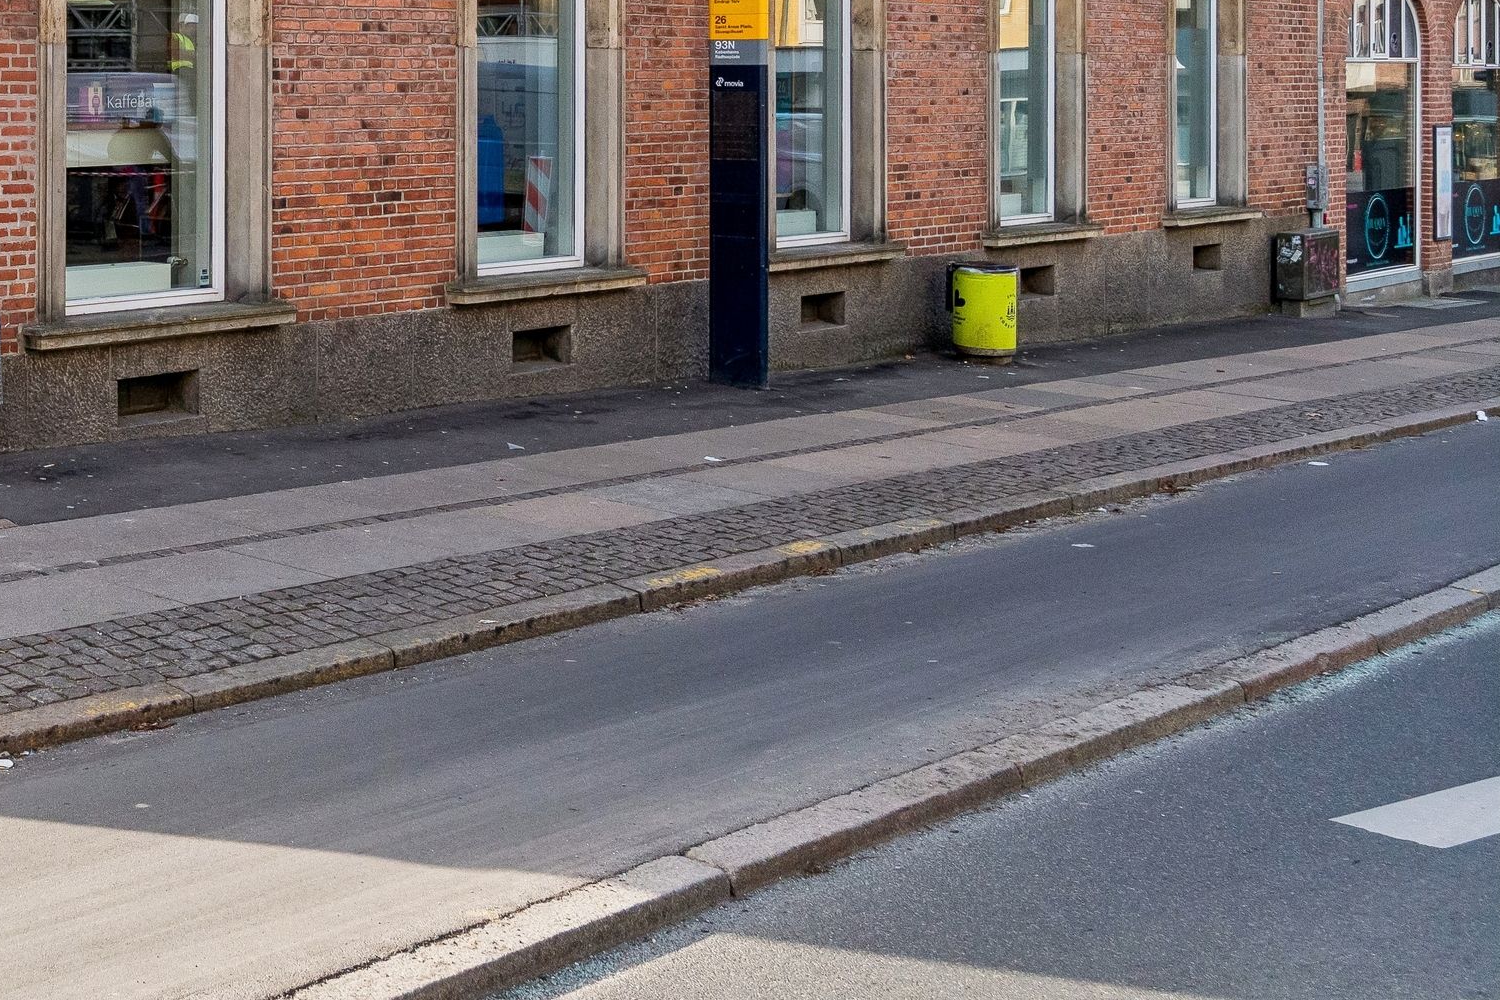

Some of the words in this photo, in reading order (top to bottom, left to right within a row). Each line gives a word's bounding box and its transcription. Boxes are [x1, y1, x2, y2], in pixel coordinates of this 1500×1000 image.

[715, 15, 727, 25] 26
[715, 40, 735, 50] 93N
[724, 79, 744, 87] movia
[106, 92, 156, 109] KaffeBar
